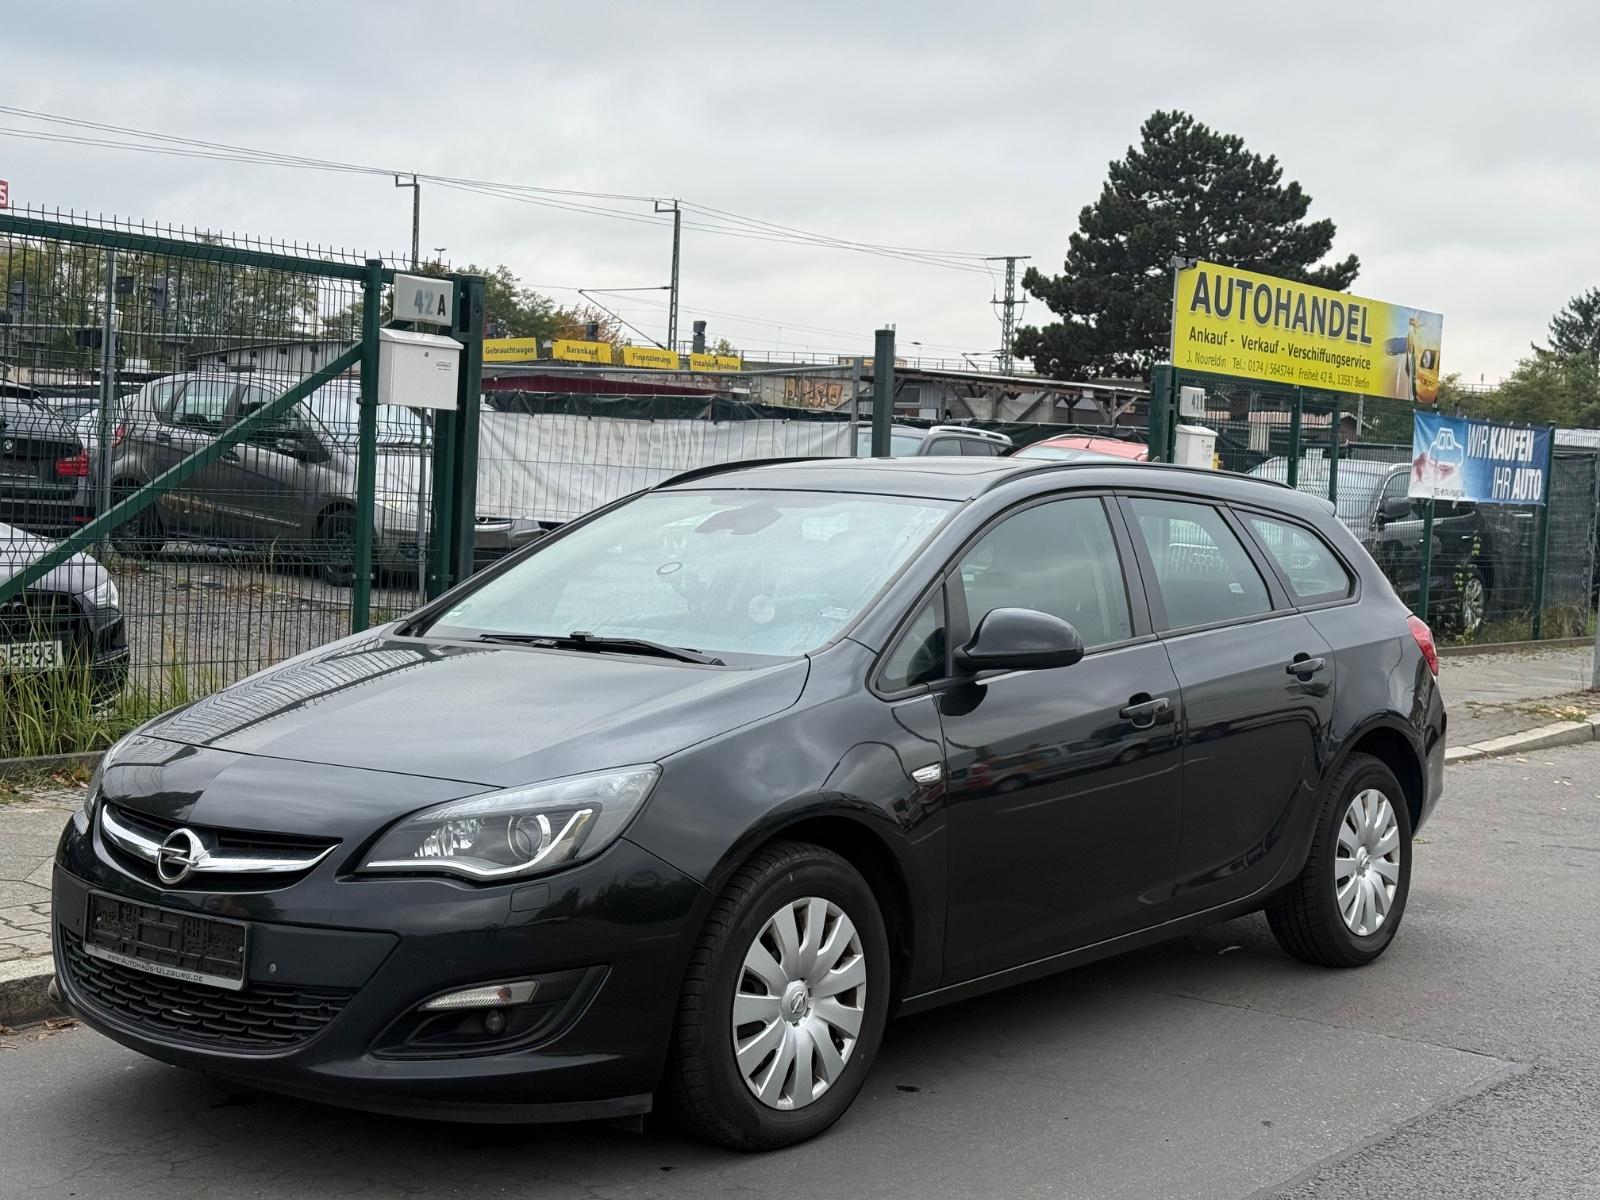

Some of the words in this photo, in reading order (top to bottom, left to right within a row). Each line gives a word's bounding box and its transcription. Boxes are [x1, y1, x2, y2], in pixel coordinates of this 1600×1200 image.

[1190, 270, 1373, 345] AUTOHANDEL
[485, 346, 535, 355] Gebrauchtwagen
[566, 345, 598, 356] Barankauf
[632, 353, 671, 366] Finanzierung
[1189, 326, 1228, 346] Ankauf
[1241, 334, 1280, 355] Verkauf
[1288, 343, 1371, 371] Verschiffungservice
[1247, 359, 1264, 373] 0174
[1320, 371, 1327, 383] 42
[1354, 376, 1370, 389] Berlin
[1467, 423, 1489, 459] WIR
[1489, 426, 1535, 463] KAUFEN
[1492, 466, 1512, 499] IHR
[1511, 468, 1542, 501] AUTO
